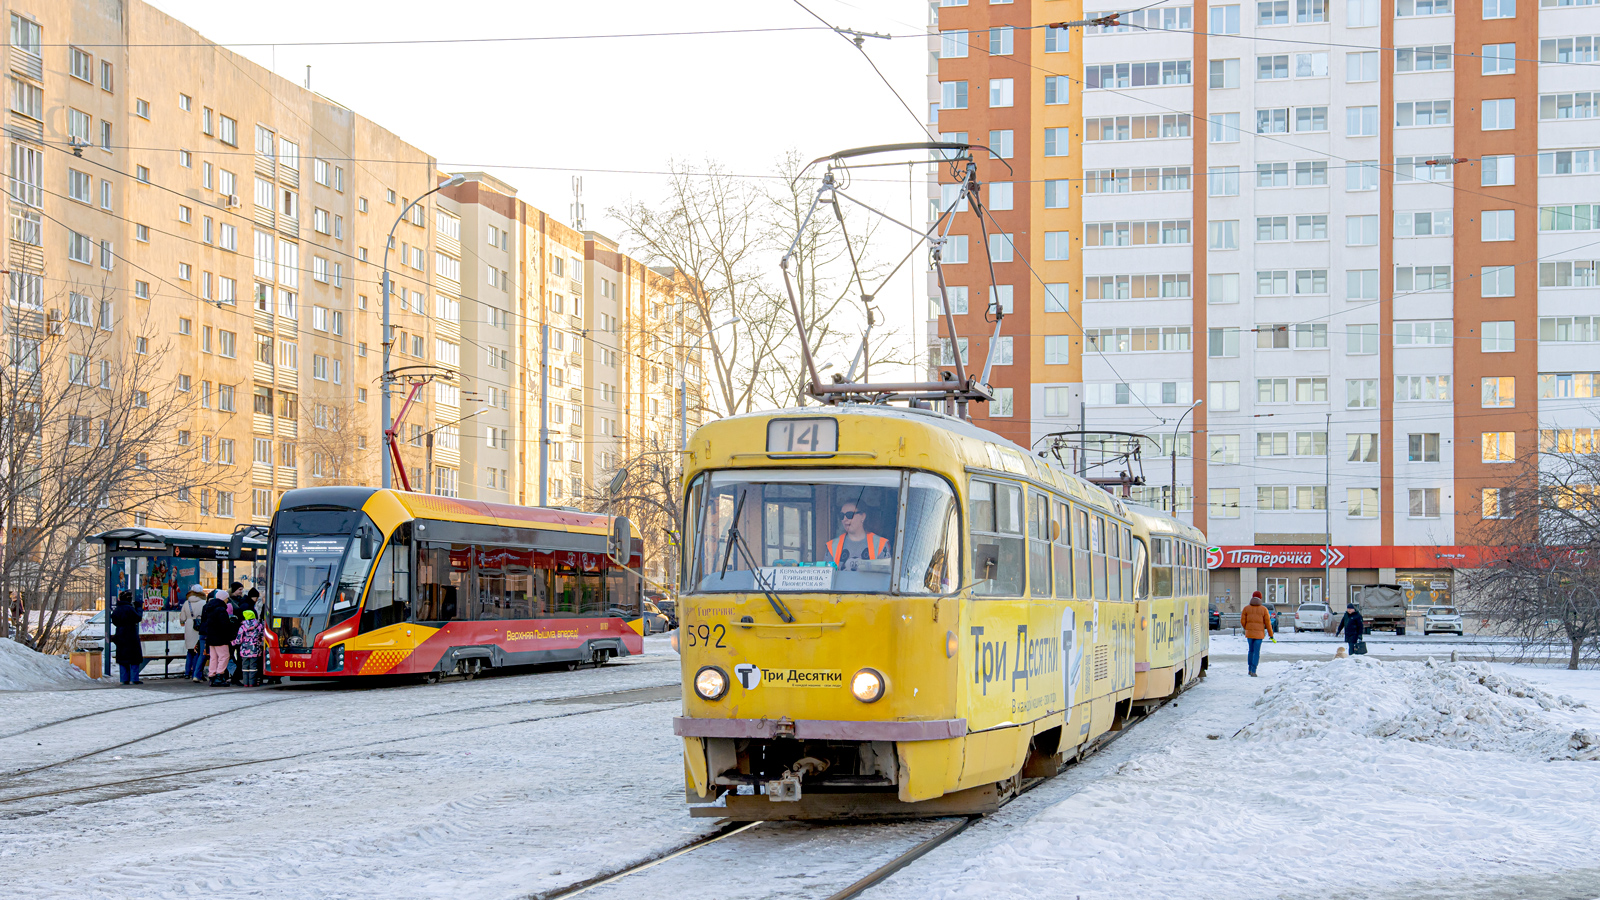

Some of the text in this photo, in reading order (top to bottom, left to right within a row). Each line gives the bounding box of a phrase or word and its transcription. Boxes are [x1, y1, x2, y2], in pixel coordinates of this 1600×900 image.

[784, 422, 819, 452] 14
[1226, 549, 1312, 567] Пятёрочка
[688, 623, 727, 648] 592
[1151, 613, 1166, 650] Три
[284, 660, 306, 669] 00161
[970, 626, 1006, 696] Три
[1011, 625, 1059, 692] Десятки
[761, 669, 842, 683] Три Десятки
